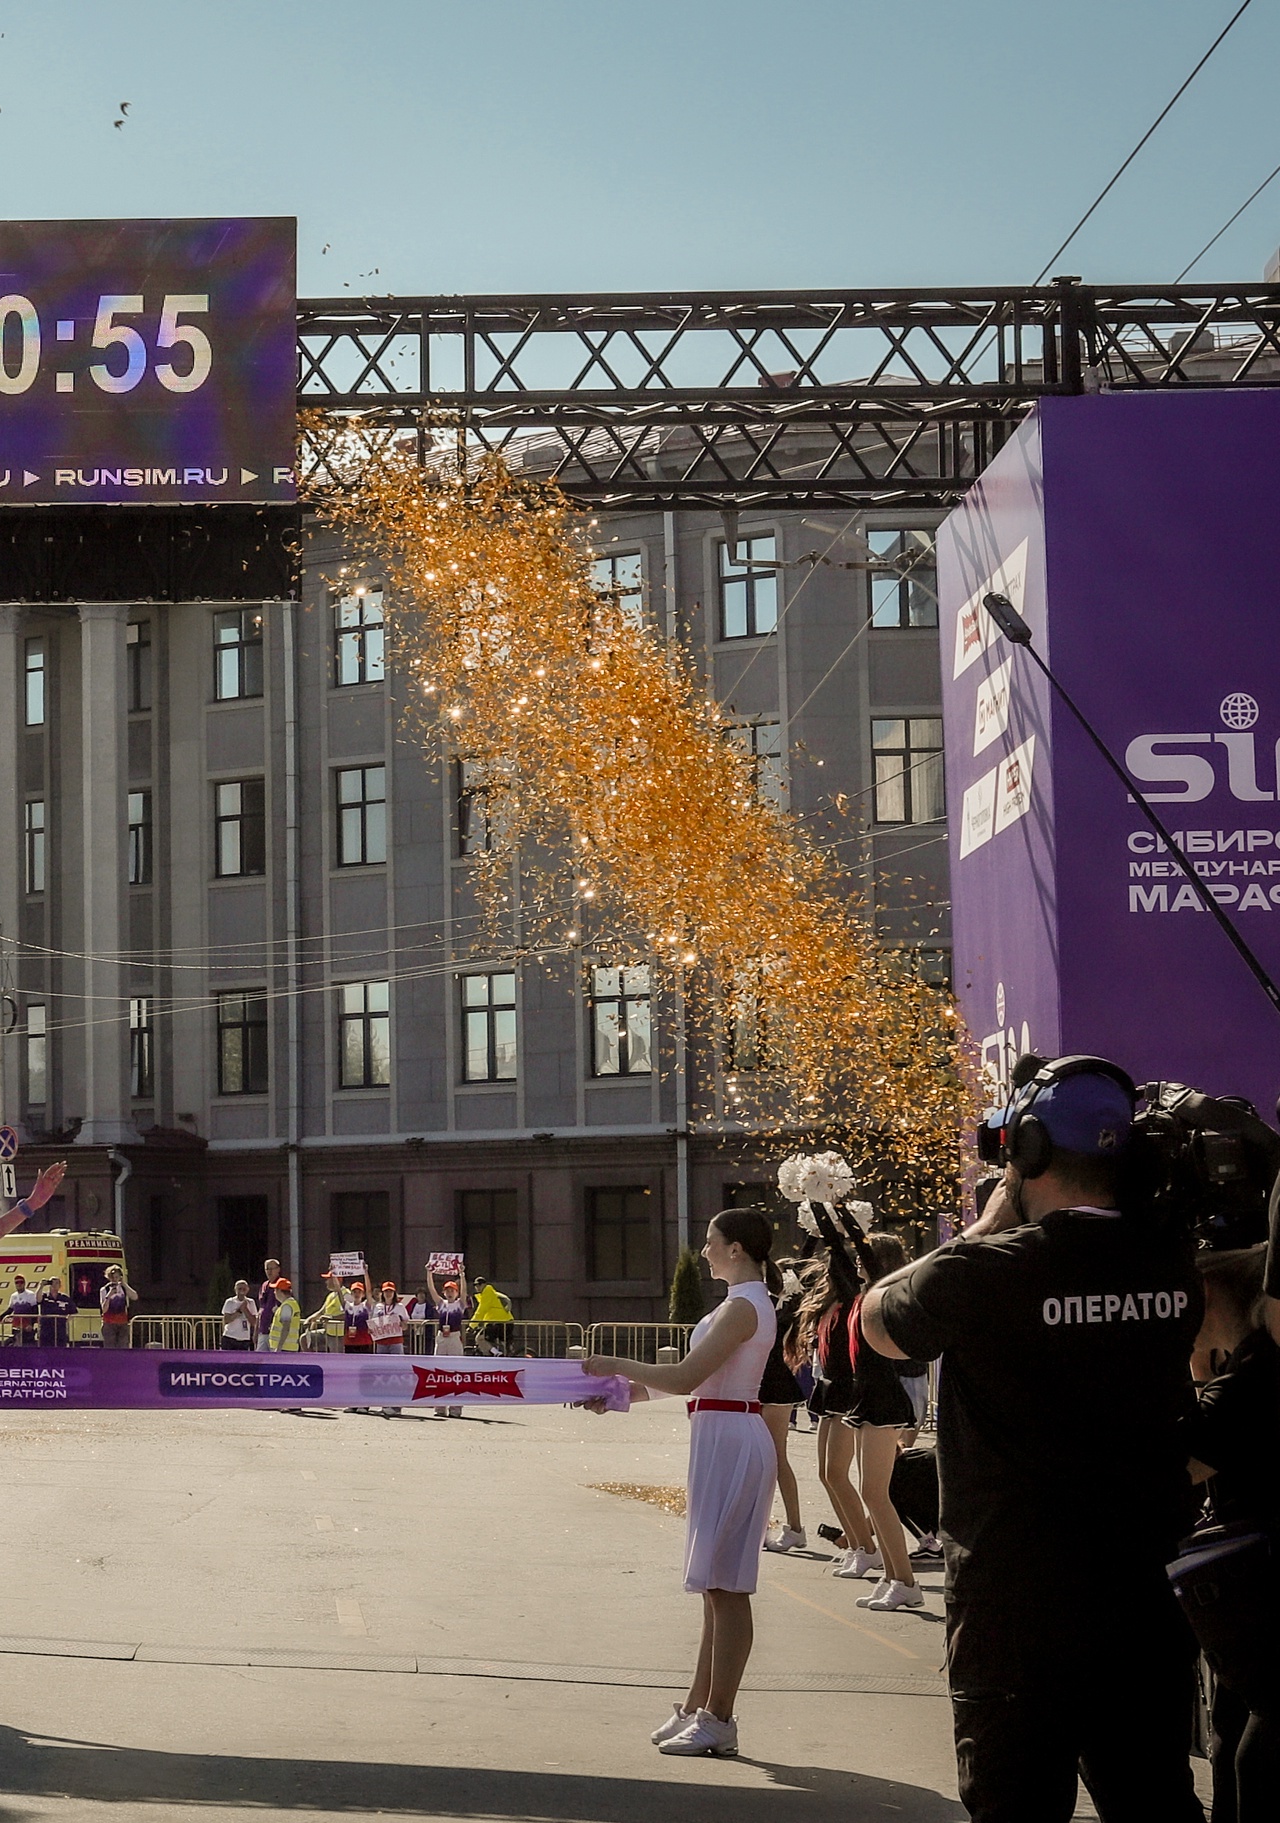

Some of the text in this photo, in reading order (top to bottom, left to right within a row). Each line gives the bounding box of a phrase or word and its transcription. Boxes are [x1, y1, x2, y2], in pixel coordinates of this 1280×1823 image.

[54, 467, 228, 487] RUNSIM.RU
[1127, 830, 1280, 854] СИБИР
[1042, 1291, 1188, 1325] ОПЕРАТОР
[170, 1372, 311, 1387] ИНГОССТРАХ
[425, 1372, 471, 1387] Альфа
[474, 1372, 509, 1384] Банк
